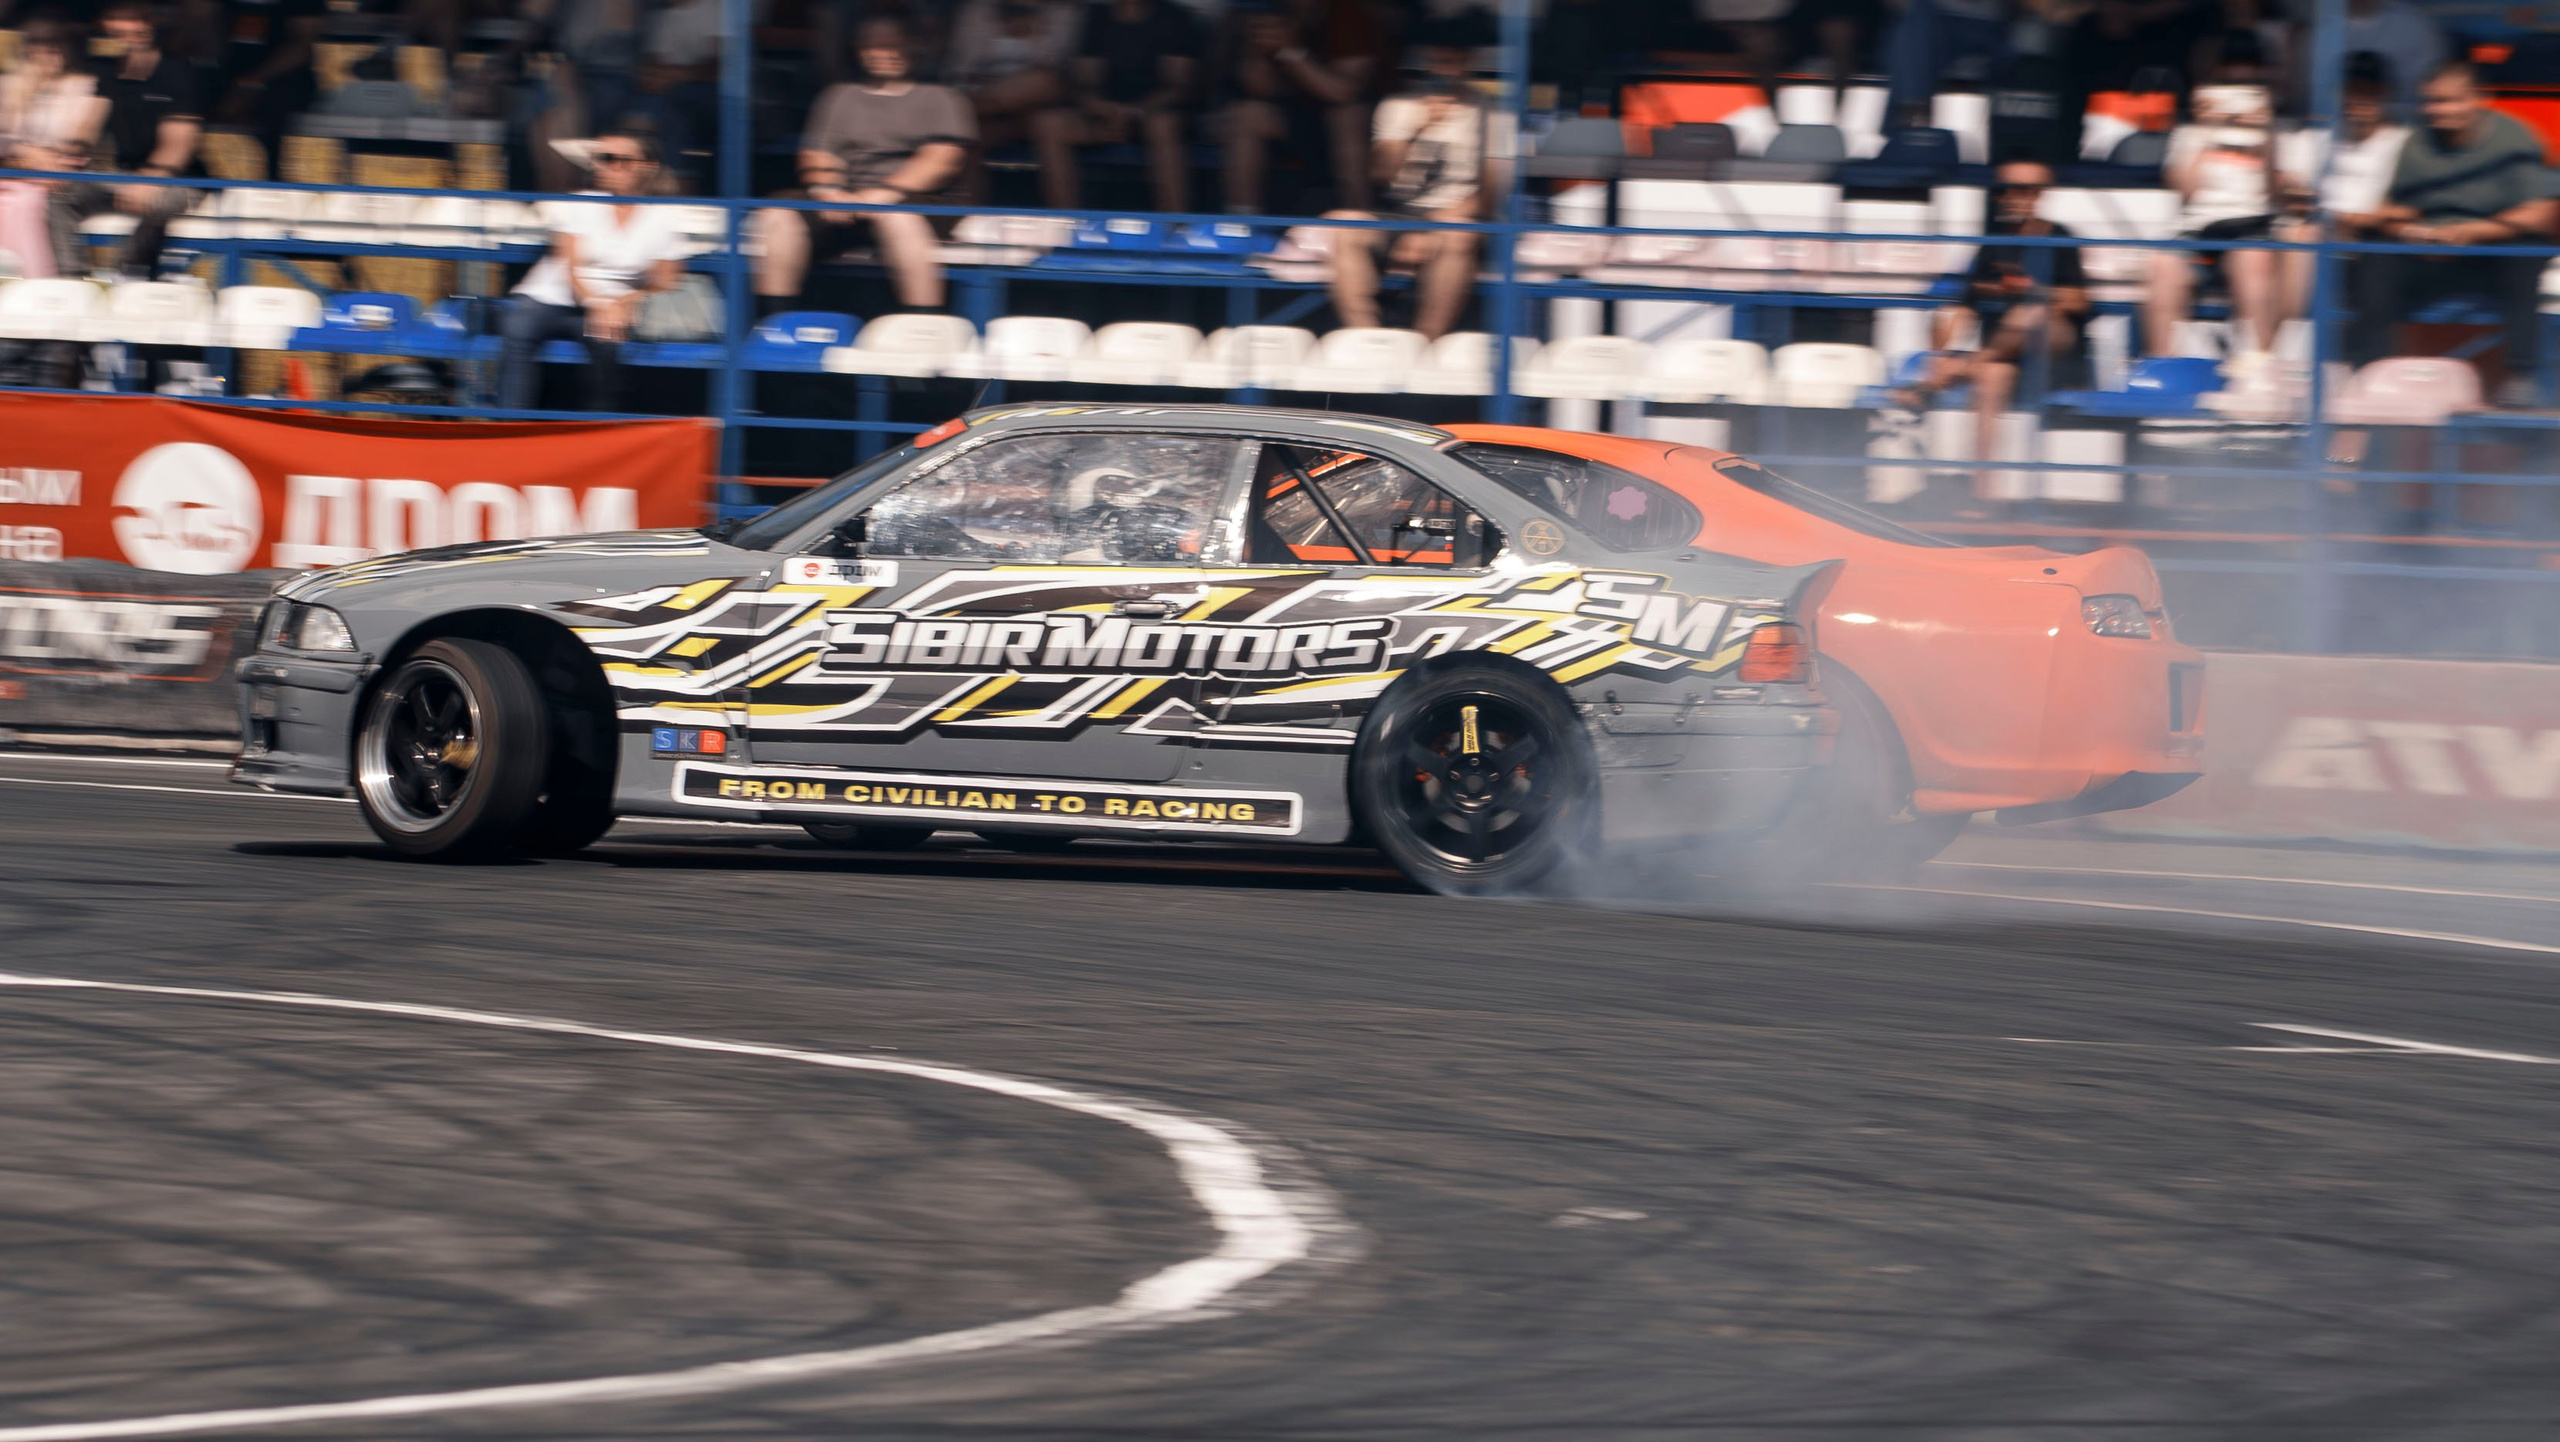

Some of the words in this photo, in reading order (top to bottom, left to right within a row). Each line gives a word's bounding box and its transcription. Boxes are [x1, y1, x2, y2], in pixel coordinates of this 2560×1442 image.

[1577, 574, 1728, 652] SM
[718, 779, 826, 799] FROM
[844, 785, 1016, 810] CIVILIAN
[1034, 795, 1086, 813] TO
[1104, 798, 1256, 820] RACING
